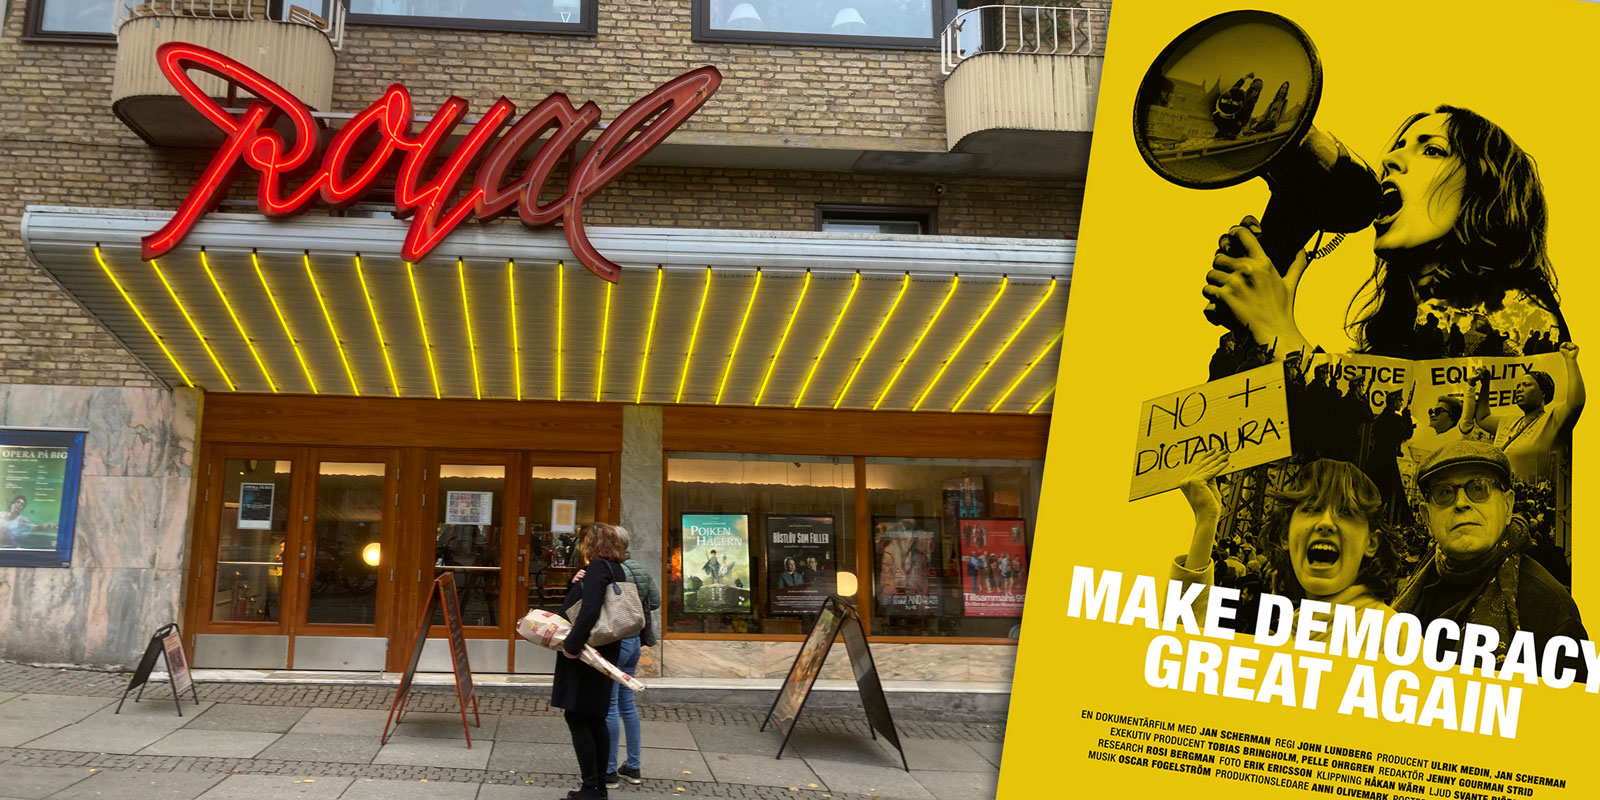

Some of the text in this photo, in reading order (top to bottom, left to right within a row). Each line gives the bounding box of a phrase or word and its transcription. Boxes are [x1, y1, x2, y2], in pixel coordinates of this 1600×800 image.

[141, 41, 722, 283] Royal
[1328, 364, 1406, 384] USTICE
[1430, 363, 1534, 386] EQLITY
[1146, 391, 1207, 437] NO
[2, 449, 69, 459] OPERA PÅ BIO
[690, 525, 731, 536] POJKEN
[1068, 566, 1600, 694] MAKE DEMOCRACY
[1145, 636, 1522, 738] GREAT AGAIN
[1081, 709, 1567, 789] EN DOKUMENTÄRFILM MED JAN SCHERMAN REGI JOHN LUNDBERG PRODUCENT ULRIK MEDIN, JAN SCHERMAN
[1087, 750, 1389, 800] MUSIK OSCAR FOGELSTRÖM PRODUKTIONSLEDARE ANNI OLIVEMARK
[1097, 738, 1144, 754] RESEARCH
[1145, 745, 1168, 757] ROSI
[1169, 748, 1216, 764] BERGMAN
[1218, 755, 1242, 768] FOTO
[1243, 759, 1266, 772] ERIK
[1266, 763, 1313, 778] ERICSSON
[1316, 770, 1362, 786] KLIPPNING
[1363, 775, 1396, 791] HÅKAN
[1397, 781, 1426, 795] WÄRN
[1428, 786, 1452, 799] LJUD
[1109, 726, 1534, 797] EXEKUTIV PRODUCENT TOBIAS BRINGHOLM, PELLE OHRGREN REDAKTÖR JENNY GOURMAN STRID
